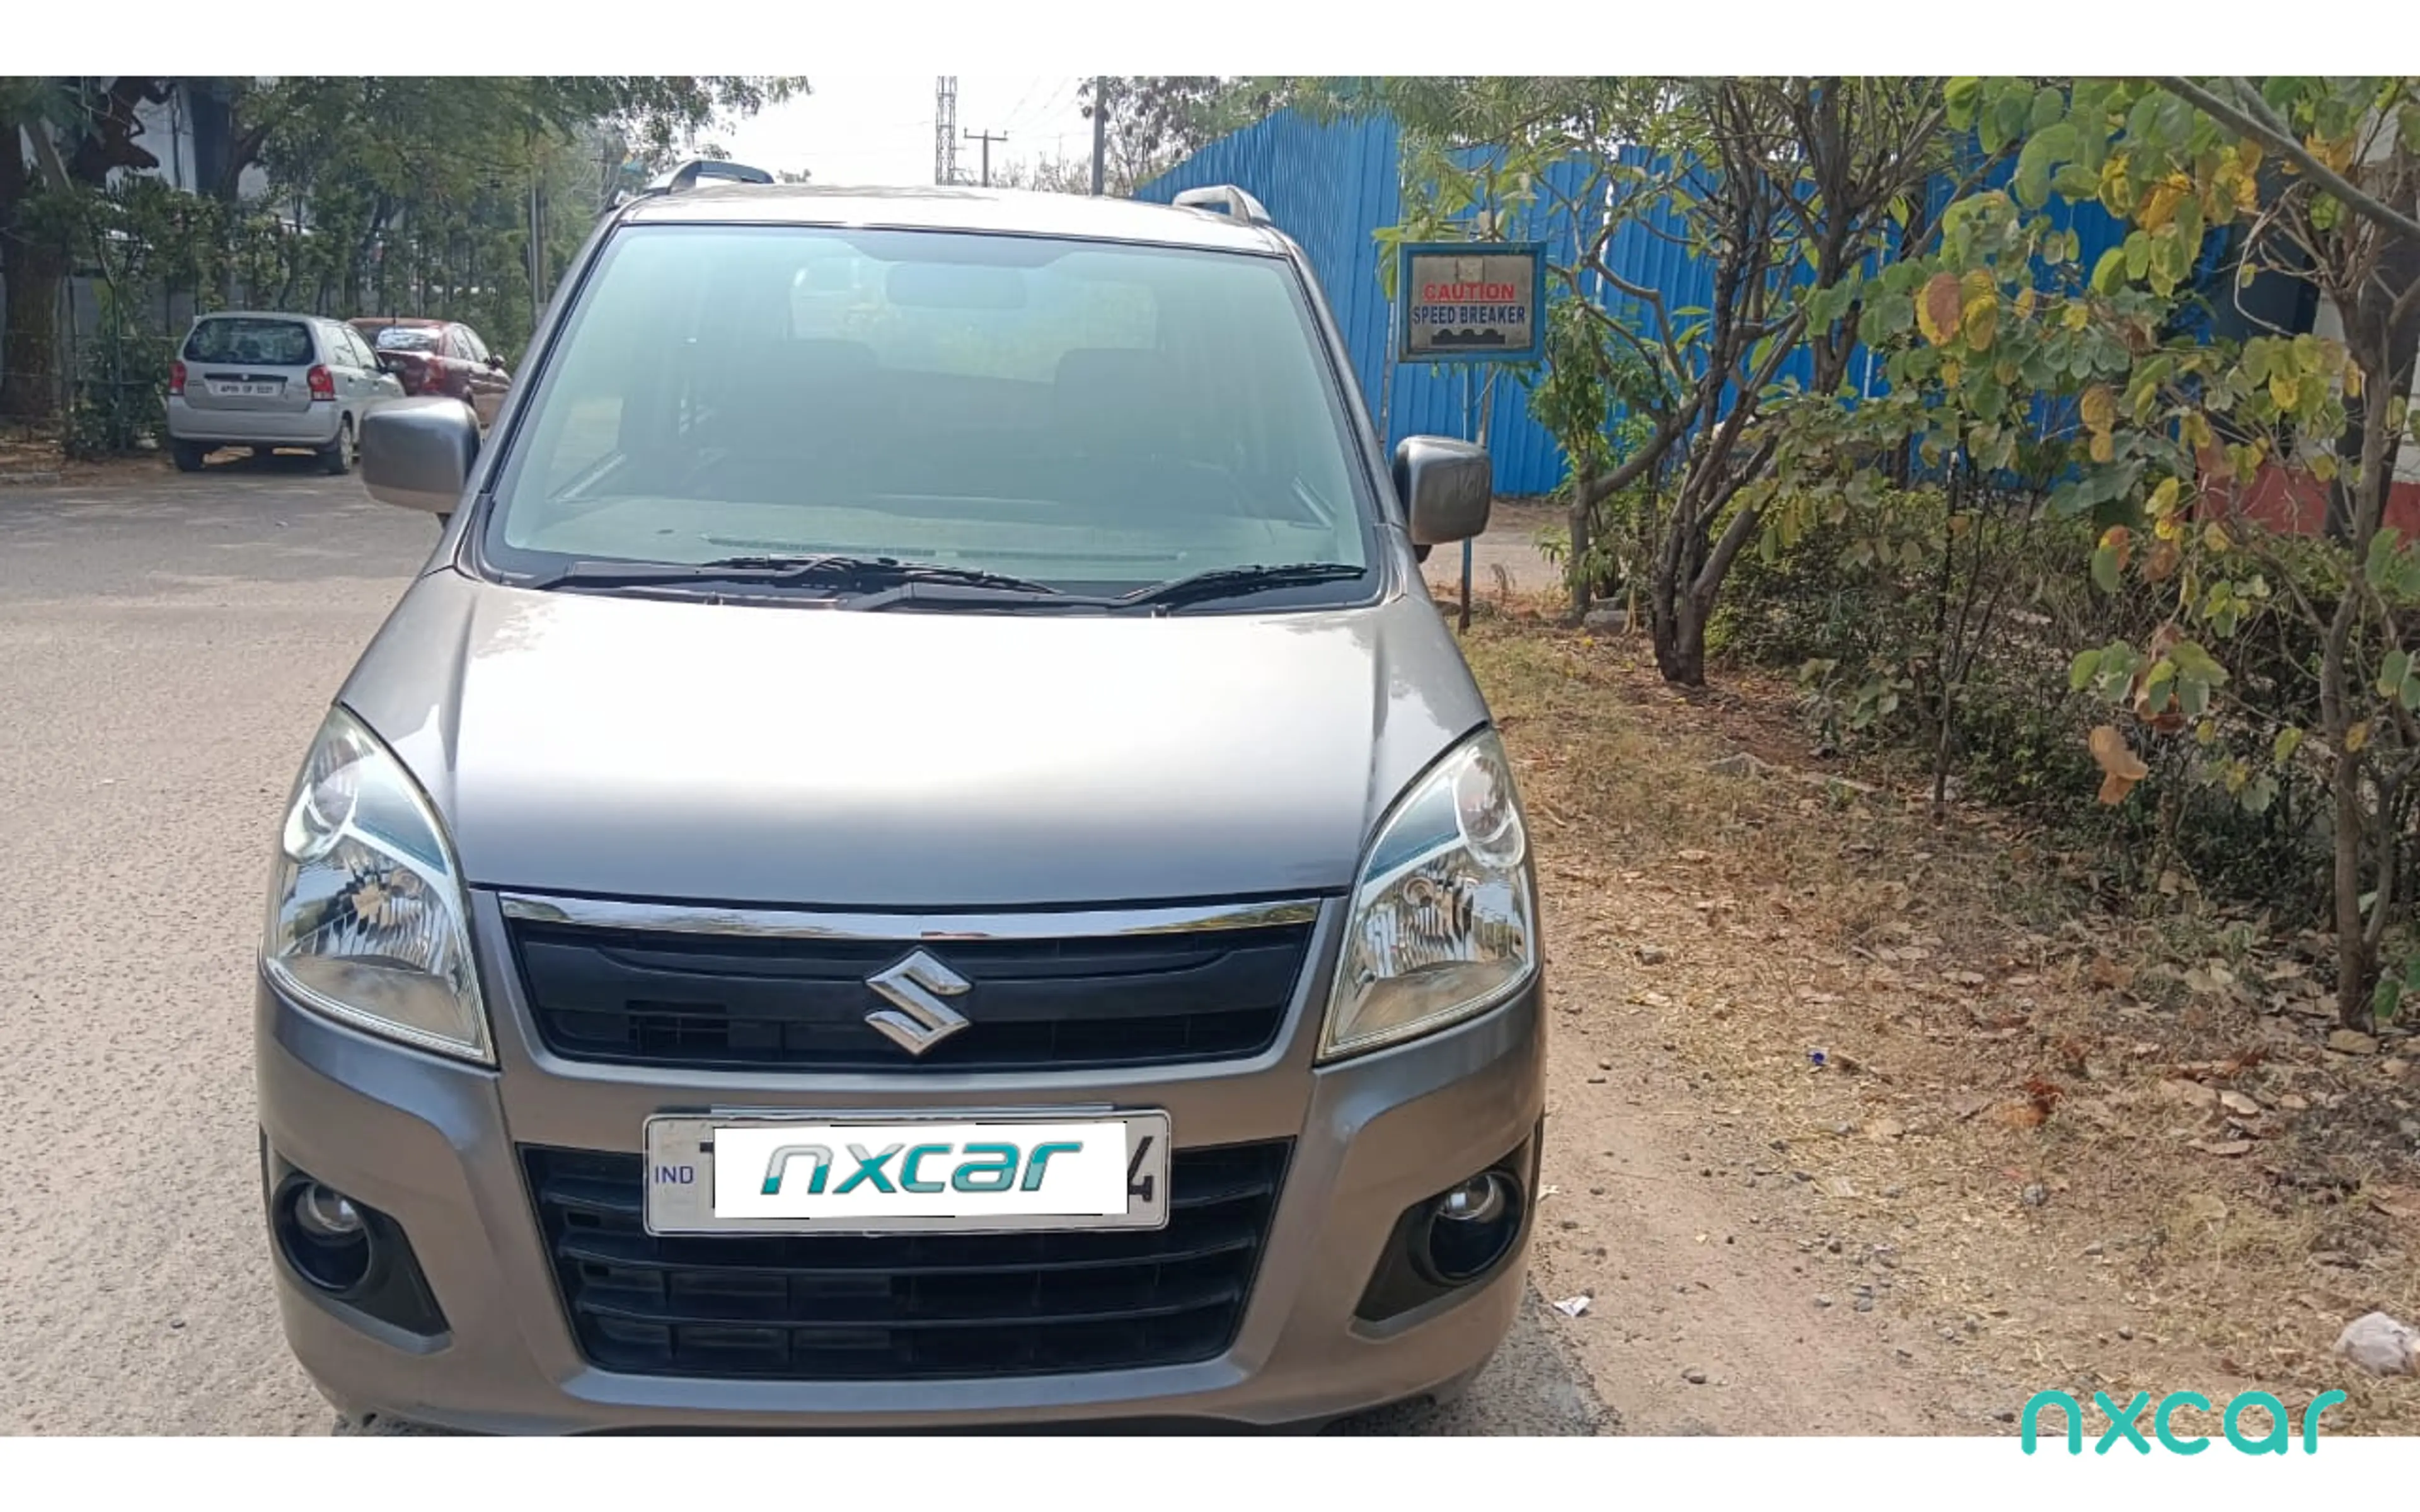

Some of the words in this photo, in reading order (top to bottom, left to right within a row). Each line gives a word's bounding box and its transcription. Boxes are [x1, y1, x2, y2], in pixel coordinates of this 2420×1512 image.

[1423, 283, 1515, 300] CAUTION
[1413, 306, 1455, 324] SPEED
[1460, 306, 1525, 324] BREAKER
[655, 1166, 693, 1184] IND
